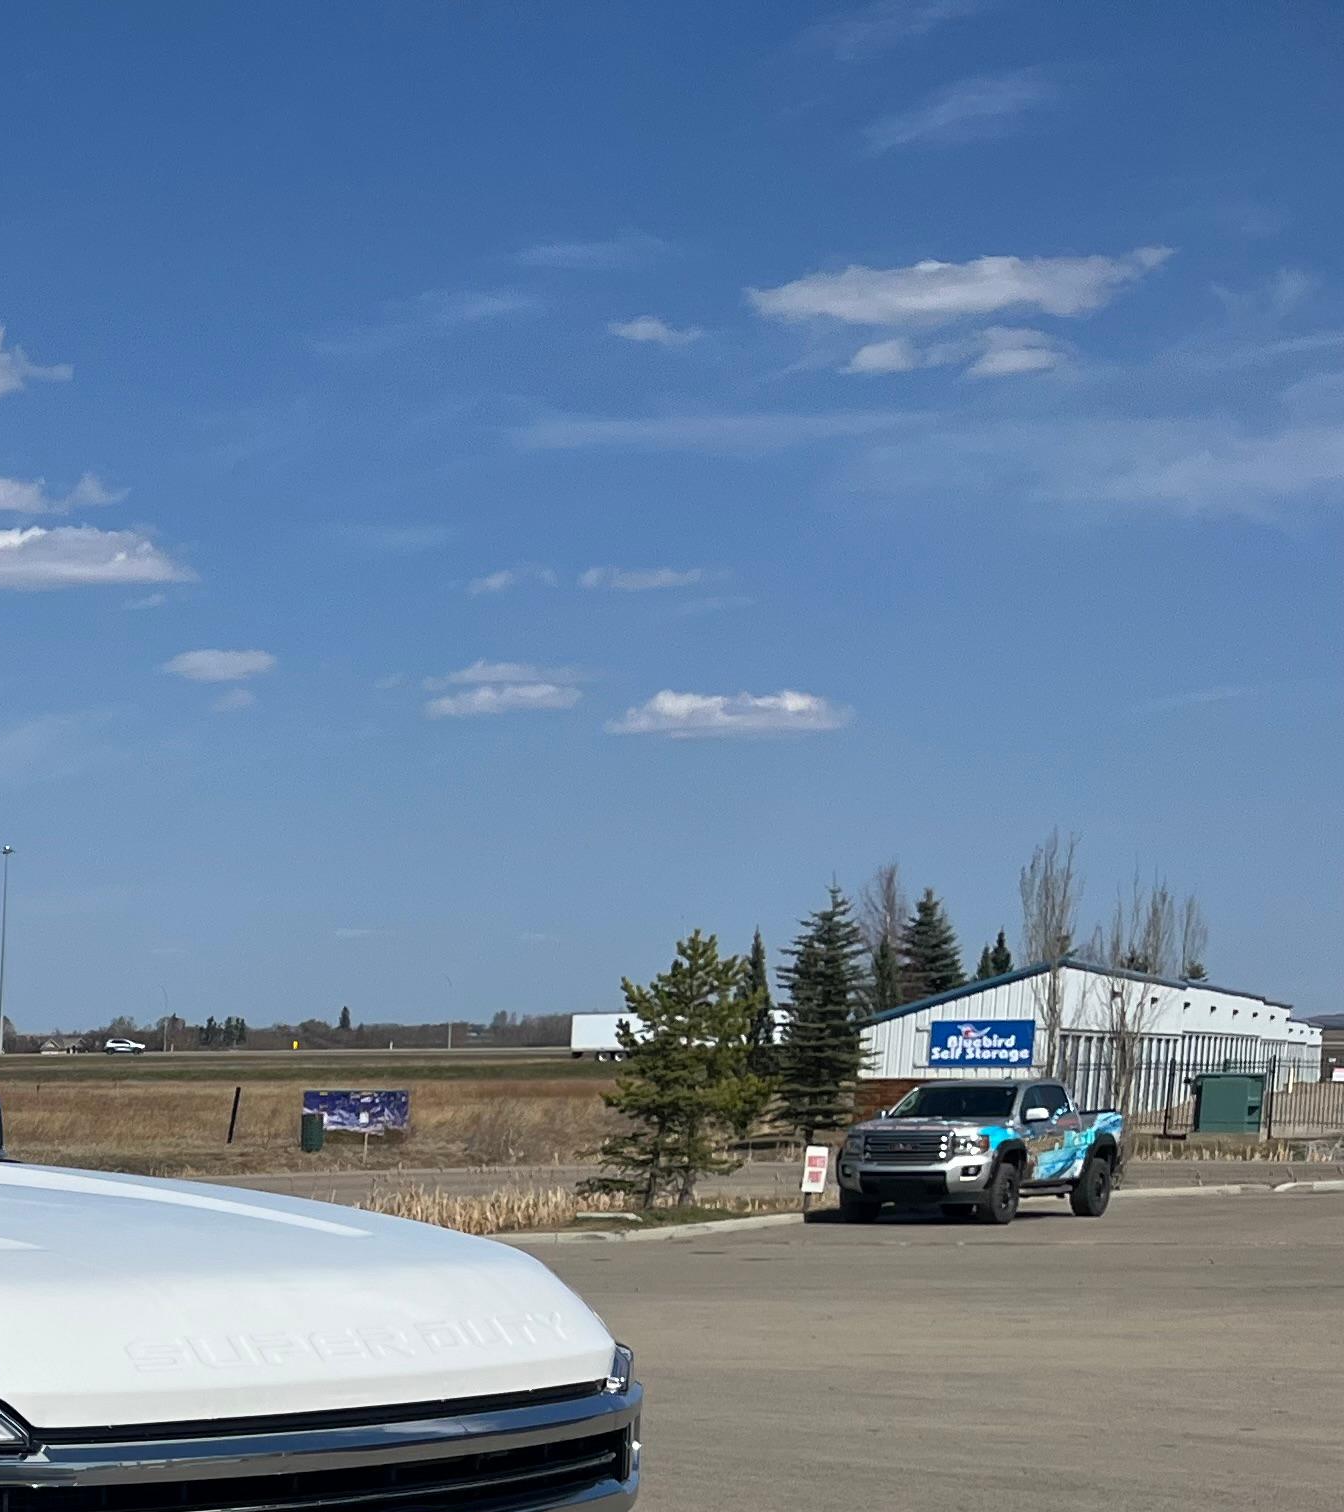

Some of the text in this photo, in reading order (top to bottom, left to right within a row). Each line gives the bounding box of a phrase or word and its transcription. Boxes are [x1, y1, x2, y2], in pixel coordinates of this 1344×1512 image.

[947, 1034, 1016, 1048] Bluebird
[931, 1047, 1030, 1062] Self Storage
[123, 1312, 570, 1373] SUPER DUTY
